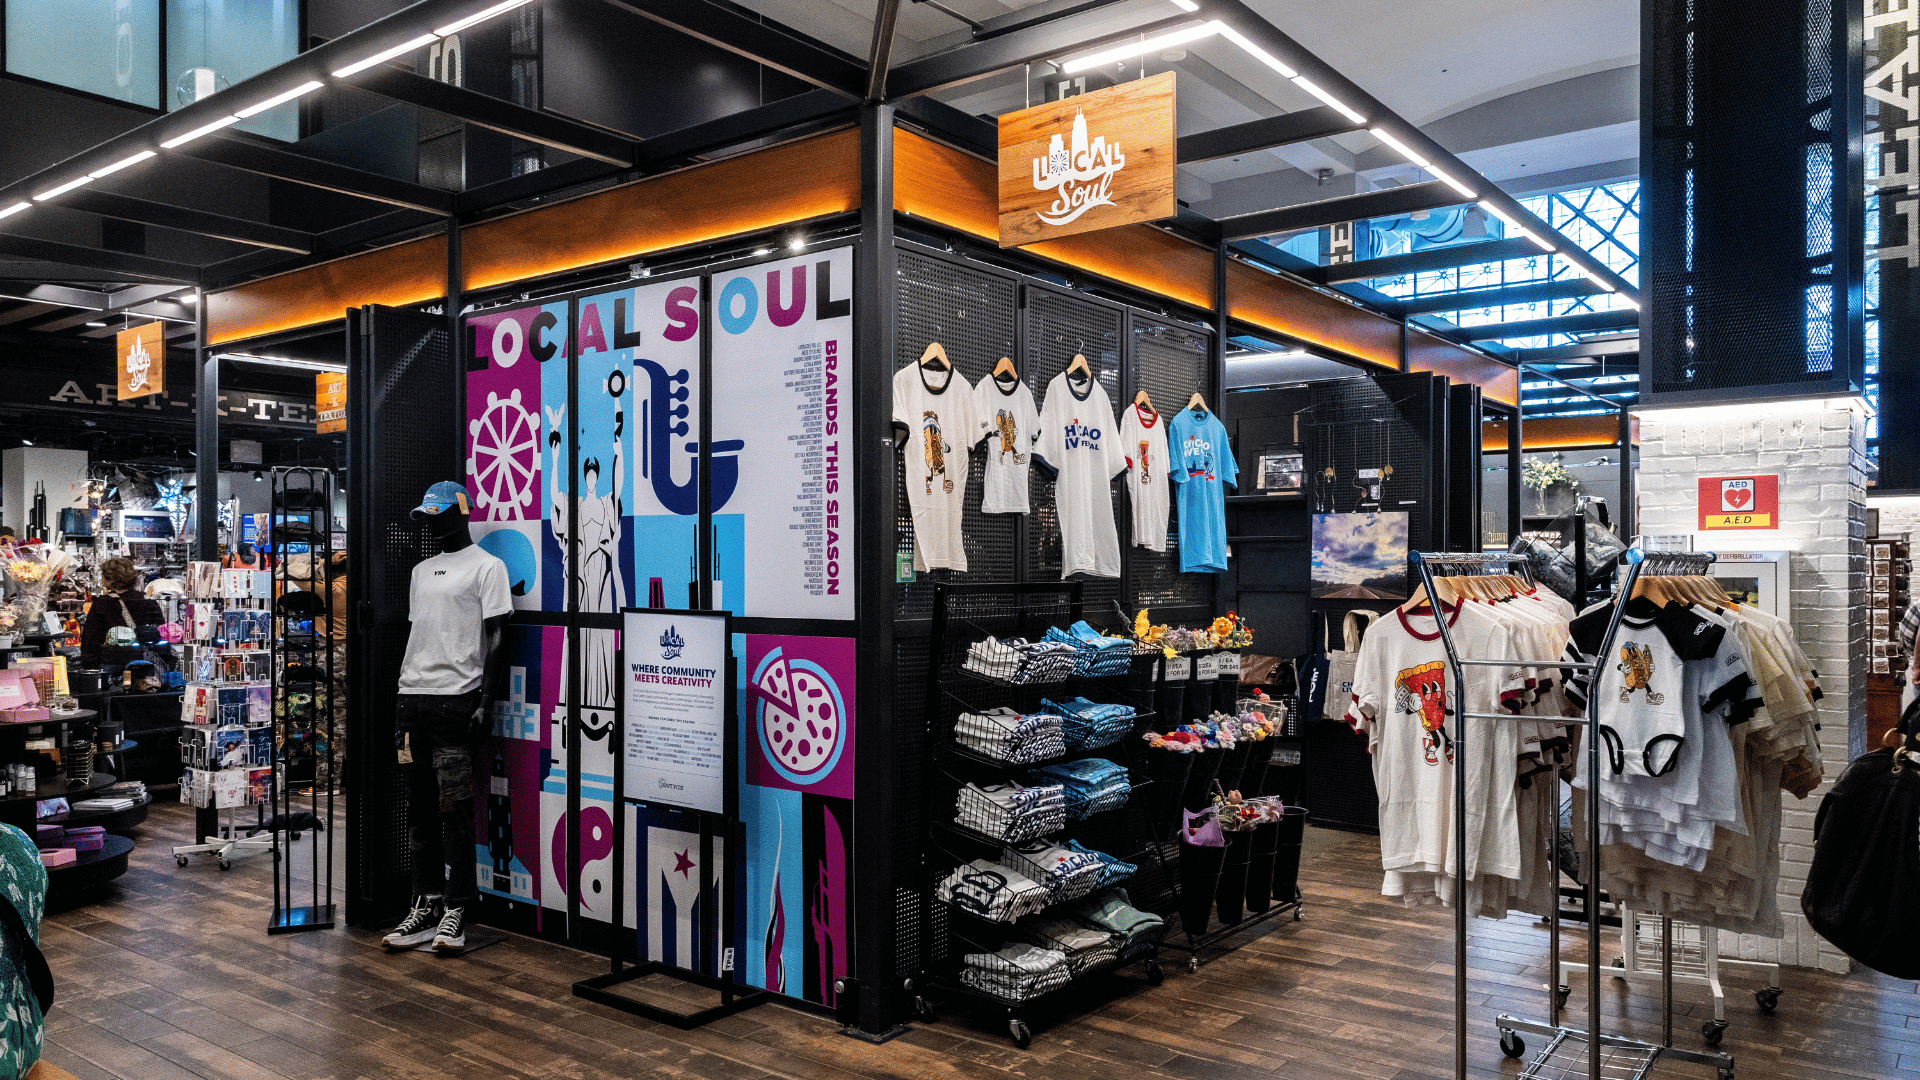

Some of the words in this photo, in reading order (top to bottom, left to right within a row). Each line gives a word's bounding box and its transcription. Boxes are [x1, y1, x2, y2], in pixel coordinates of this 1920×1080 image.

[1045, 172, 1113, 215] Soul
[467, 298, 640, 372] LOCAL
[663, 260, 850, 342] SOUL
[328, 382, 343, 394] ART
[826, 340, 838, 436] BRANDS
[826, 441, 839, 494] THIS
[1728, 481, 1747, 489] AED
[1723, 516, 1752, 524] A.E.D
[827, 500, 840, 595] SEASON
[631, 663, 660, 675] WHERE
[661, 665, 717, 679] COMMUNITY
[634, 674, 660, 684] MEETS
[661, 676, 713, 688] CREATIVITY
